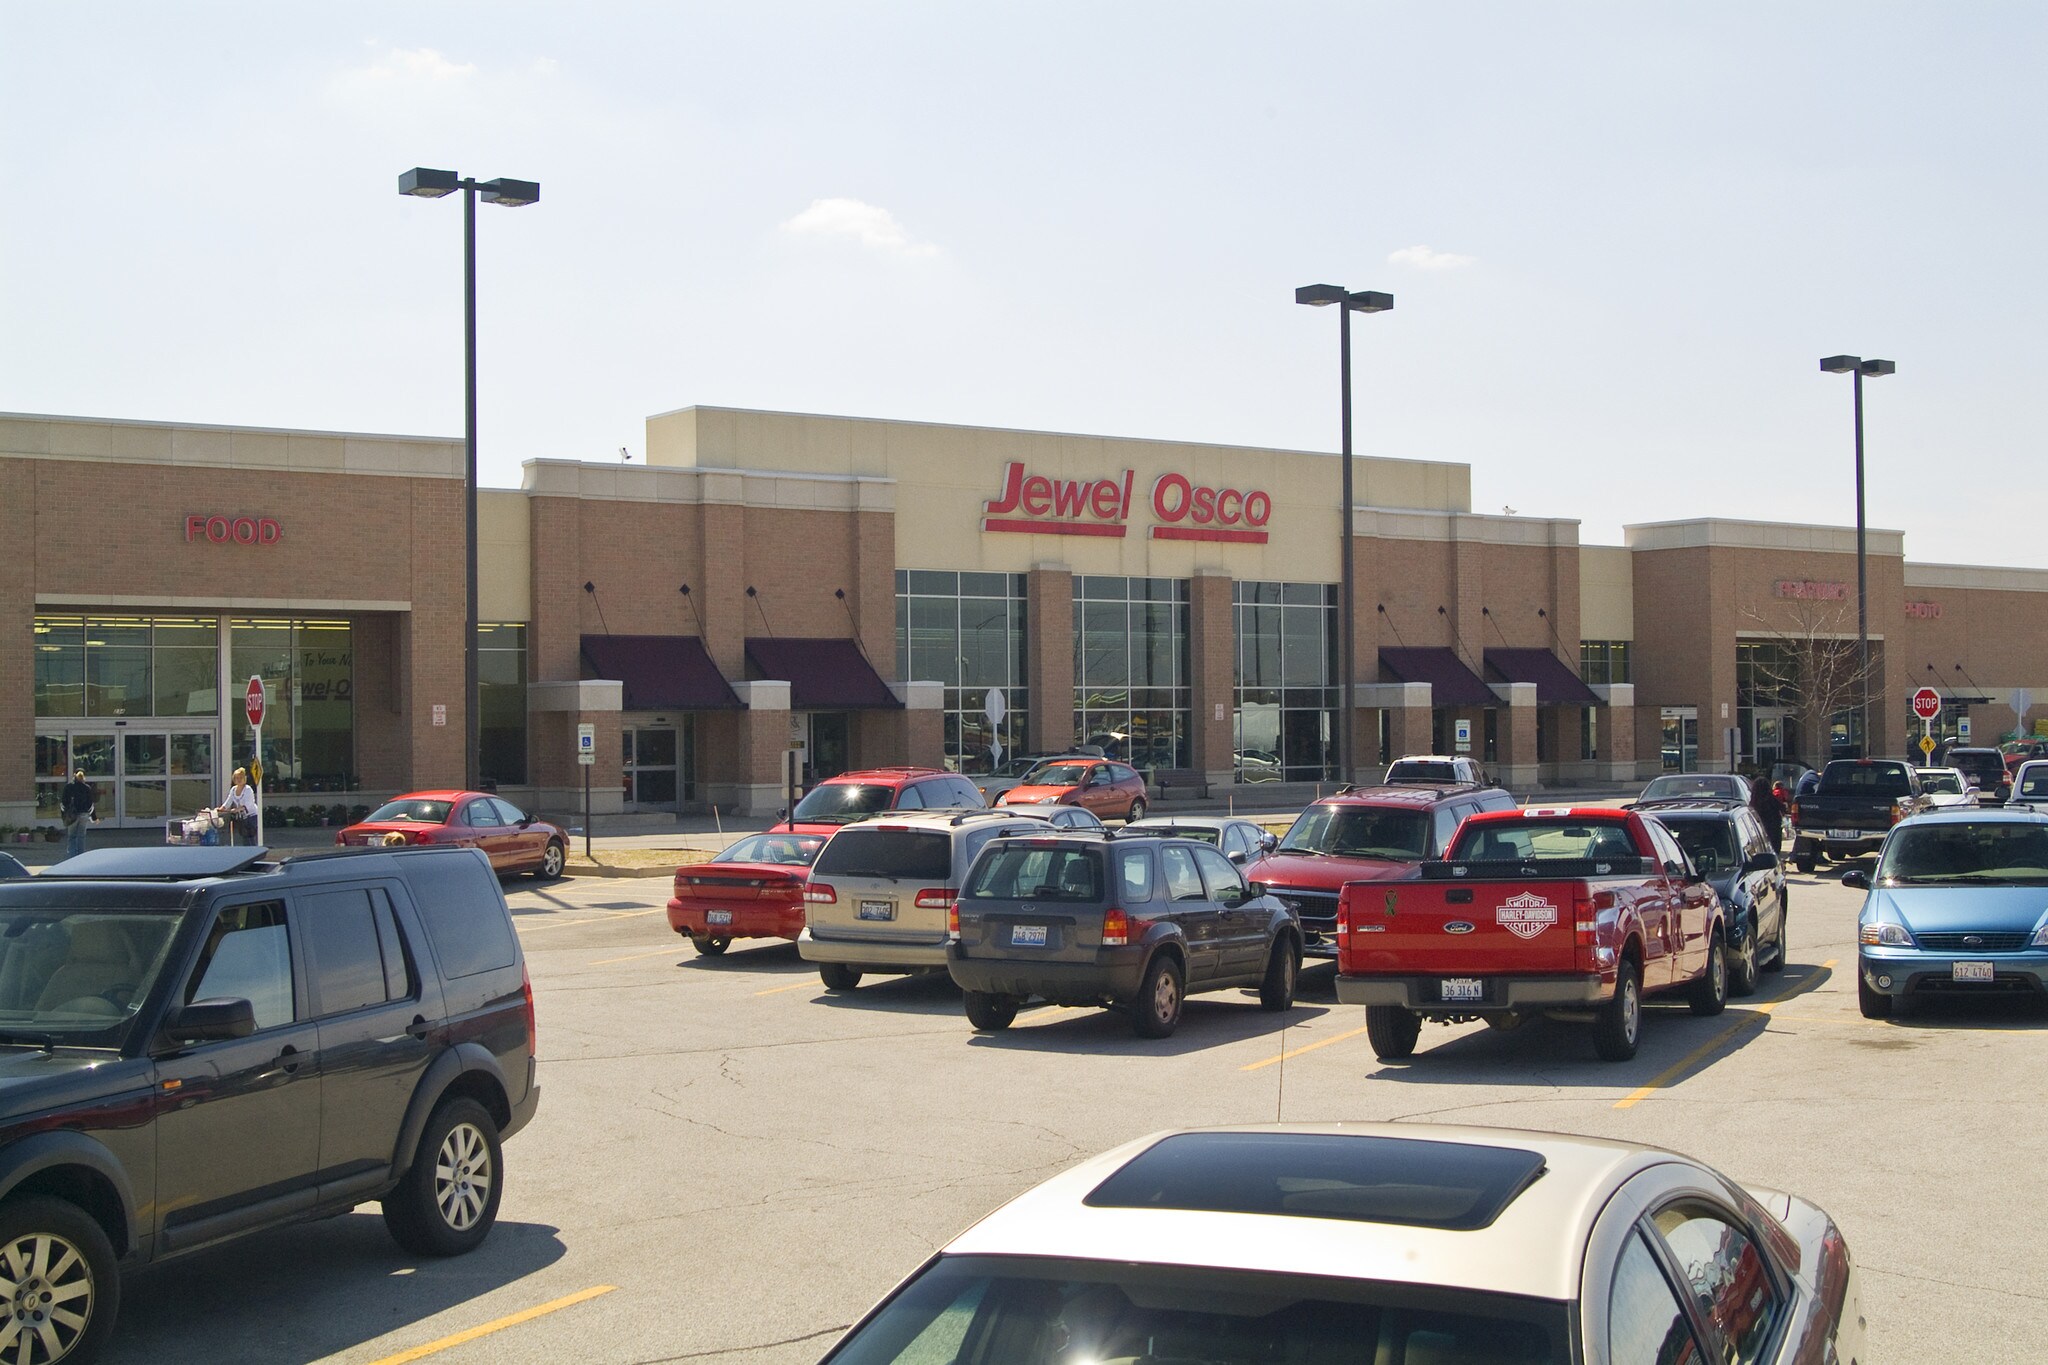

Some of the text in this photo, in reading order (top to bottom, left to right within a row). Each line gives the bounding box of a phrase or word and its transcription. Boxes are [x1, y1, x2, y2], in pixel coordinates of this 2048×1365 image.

[983, 462, 1272, 527] Jewel Osco
[186, 515, 282, 545] FOOD
[1904, 602, 1942, 618] PHOTO
[247, 693, 263, 711] STOP
[1915, 697, 1937, 709] STOP
[1513, 898, 1541, 908] MOTOR
[1501, 910, 1553, 920] HARLEY-DAVIDSON
[1450, 922, 1468, 932] Ford
[1513, 922, 1542, 934] CYCLES
[1954, 967, 1992, 978] 612 4740
[1444, 985, 1479, 996] 36 316 N
